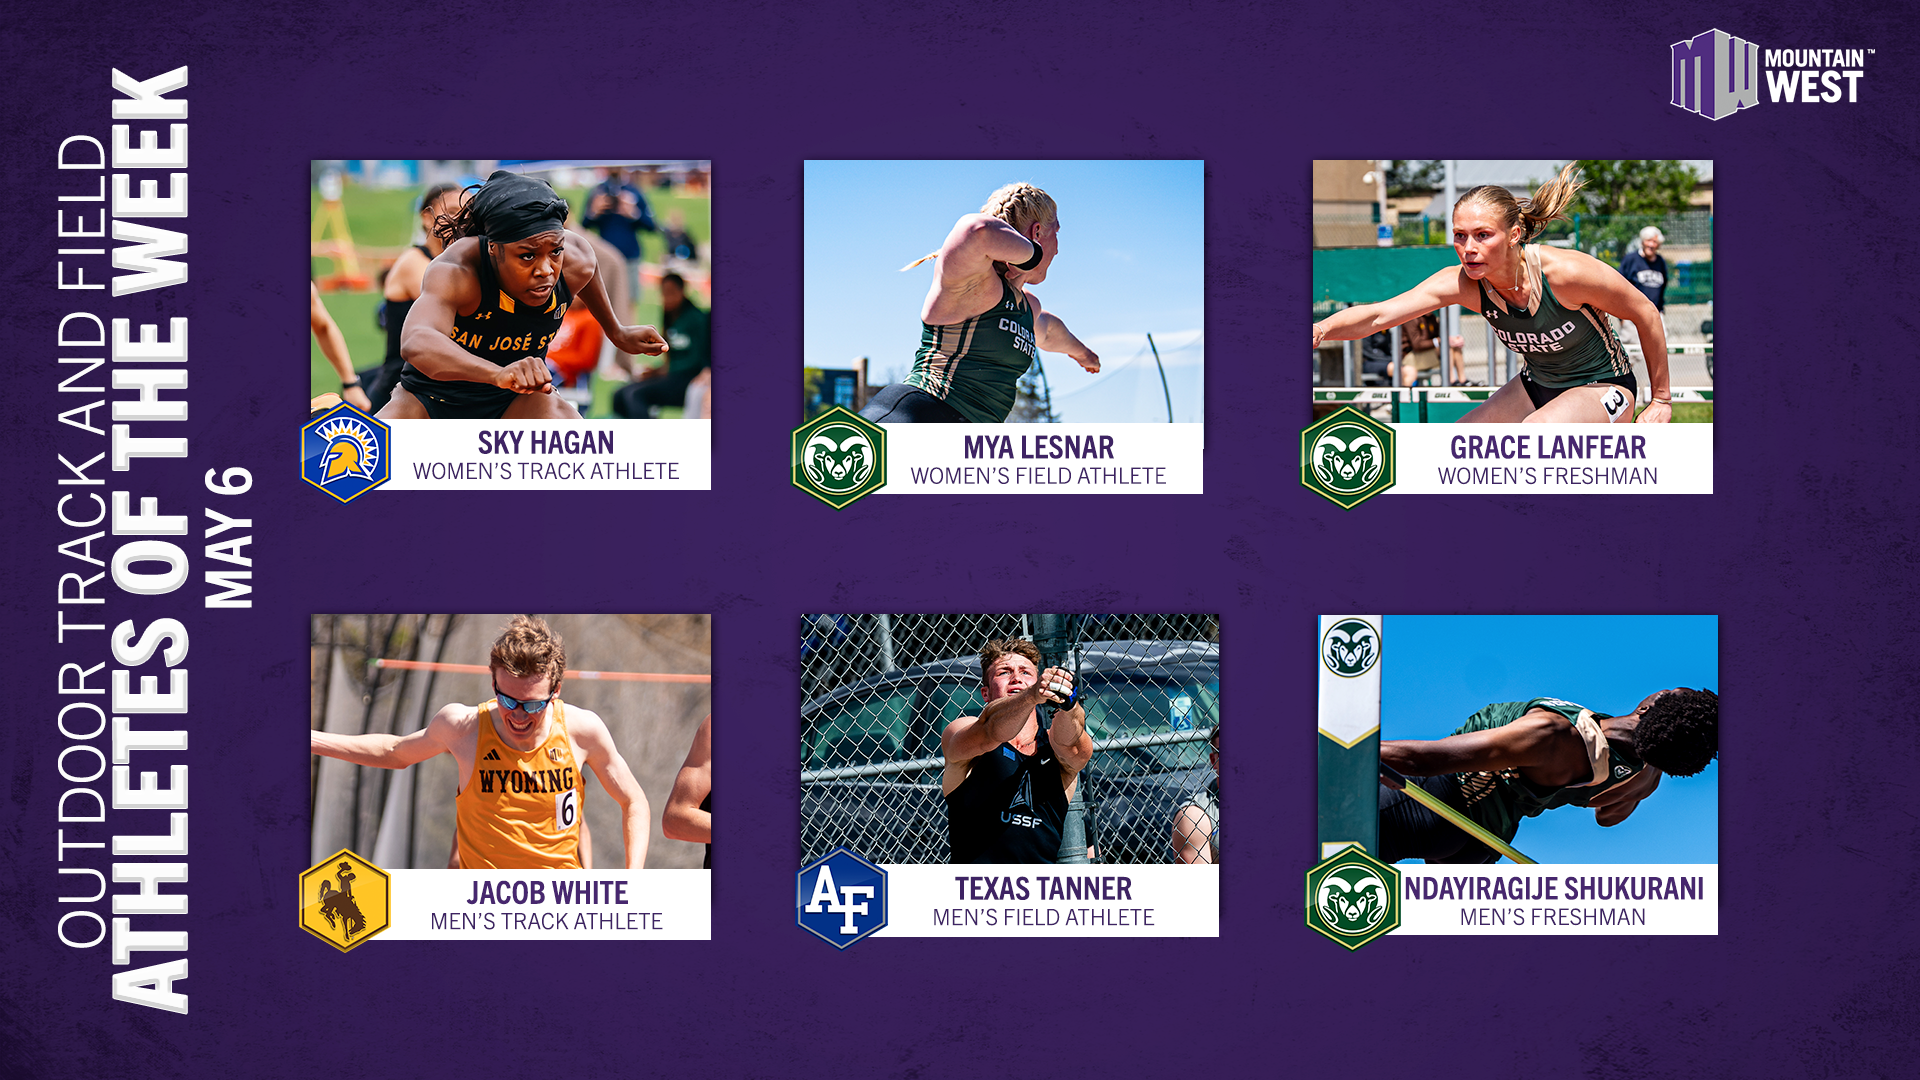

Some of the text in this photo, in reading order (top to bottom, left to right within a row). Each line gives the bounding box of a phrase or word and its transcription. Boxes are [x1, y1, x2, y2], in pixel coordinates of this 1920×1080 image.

[450, 326, 560, 351] SAN JOSÉ ST
[1013, 336, 1036, 359] STATE
[1508, 341, 1564, 353] STATE
[1604, 389, 1625, 416] 3
[479, 767, 573, 793] WYOMING
[561, 791, 574, 826] 6
[1001, 811, 1042, 828] USSF
